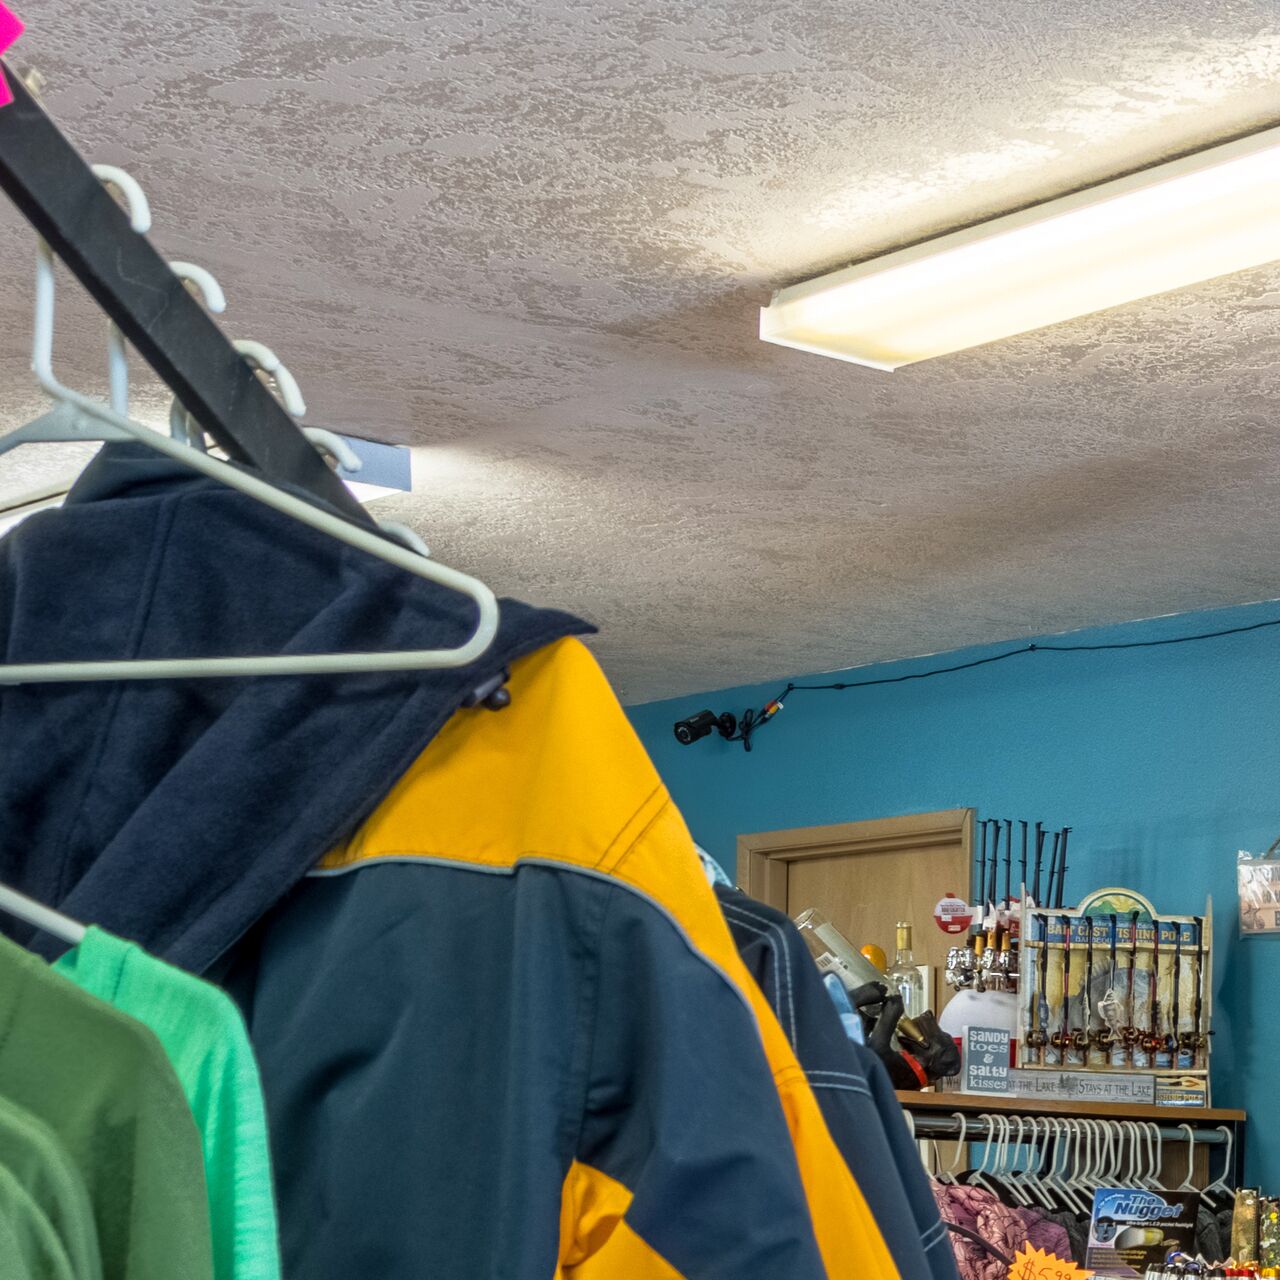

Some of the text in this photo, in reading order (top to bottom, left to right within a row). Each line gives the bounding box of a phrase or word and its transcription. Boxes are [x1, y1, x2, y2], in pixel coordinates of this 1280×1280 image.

[970, 1043, 1008, 1053] toes
[983, 1054, 994, 1065] &
[969, 1077, 1008, 1090] kisses
[1018, 1078, 1151, 1097] THE LAKE STAYS AT THE LAKE
[1130, 1194, 1155, 1205] The
[1114, 1201, 1184, 1219] Nugget
